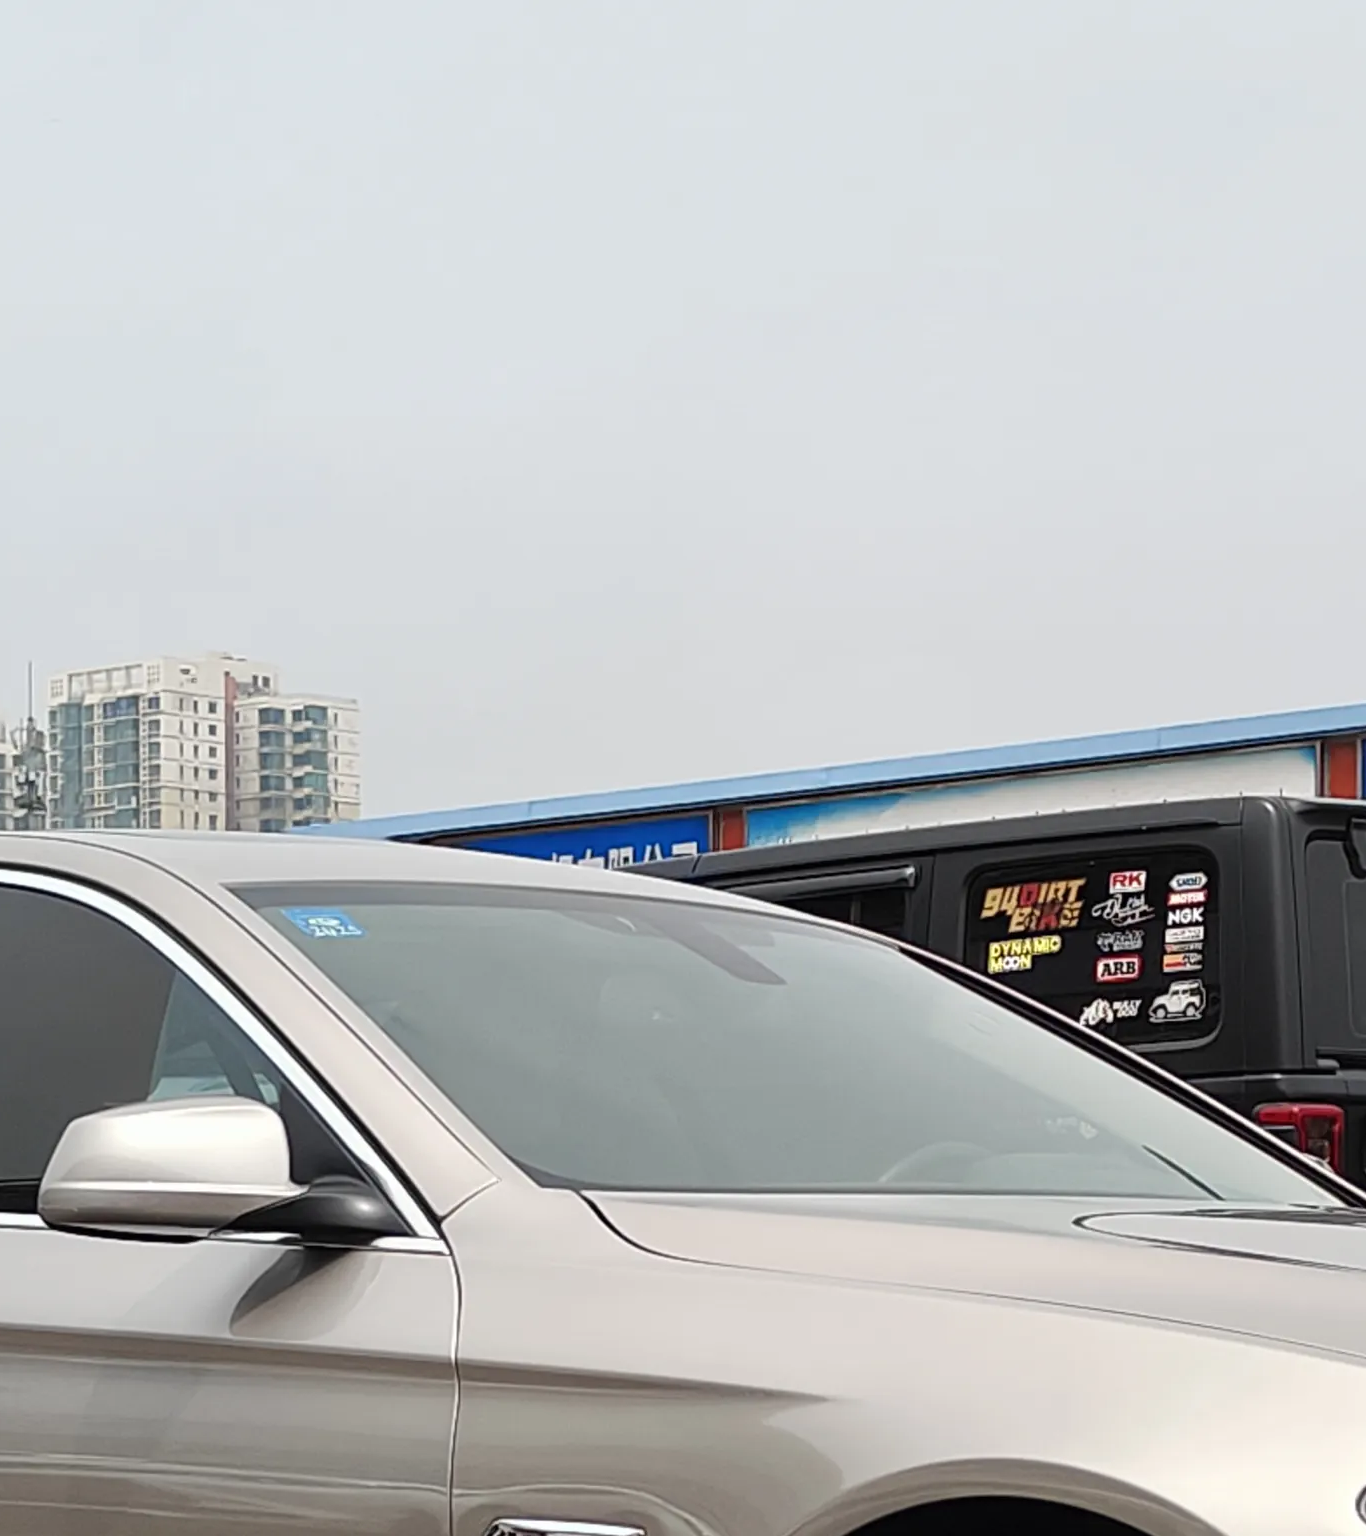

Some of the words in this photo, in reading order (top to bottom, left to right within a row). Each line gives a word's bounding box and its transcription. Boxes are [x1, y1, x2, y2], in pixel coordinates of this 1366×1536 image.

[1113, 873, 1143, 887] RK
[1167, 906, 1205, 926] NGK
[988, 956, 1033, 974] MOON
[1101, 961, 1136, 978] ARB
